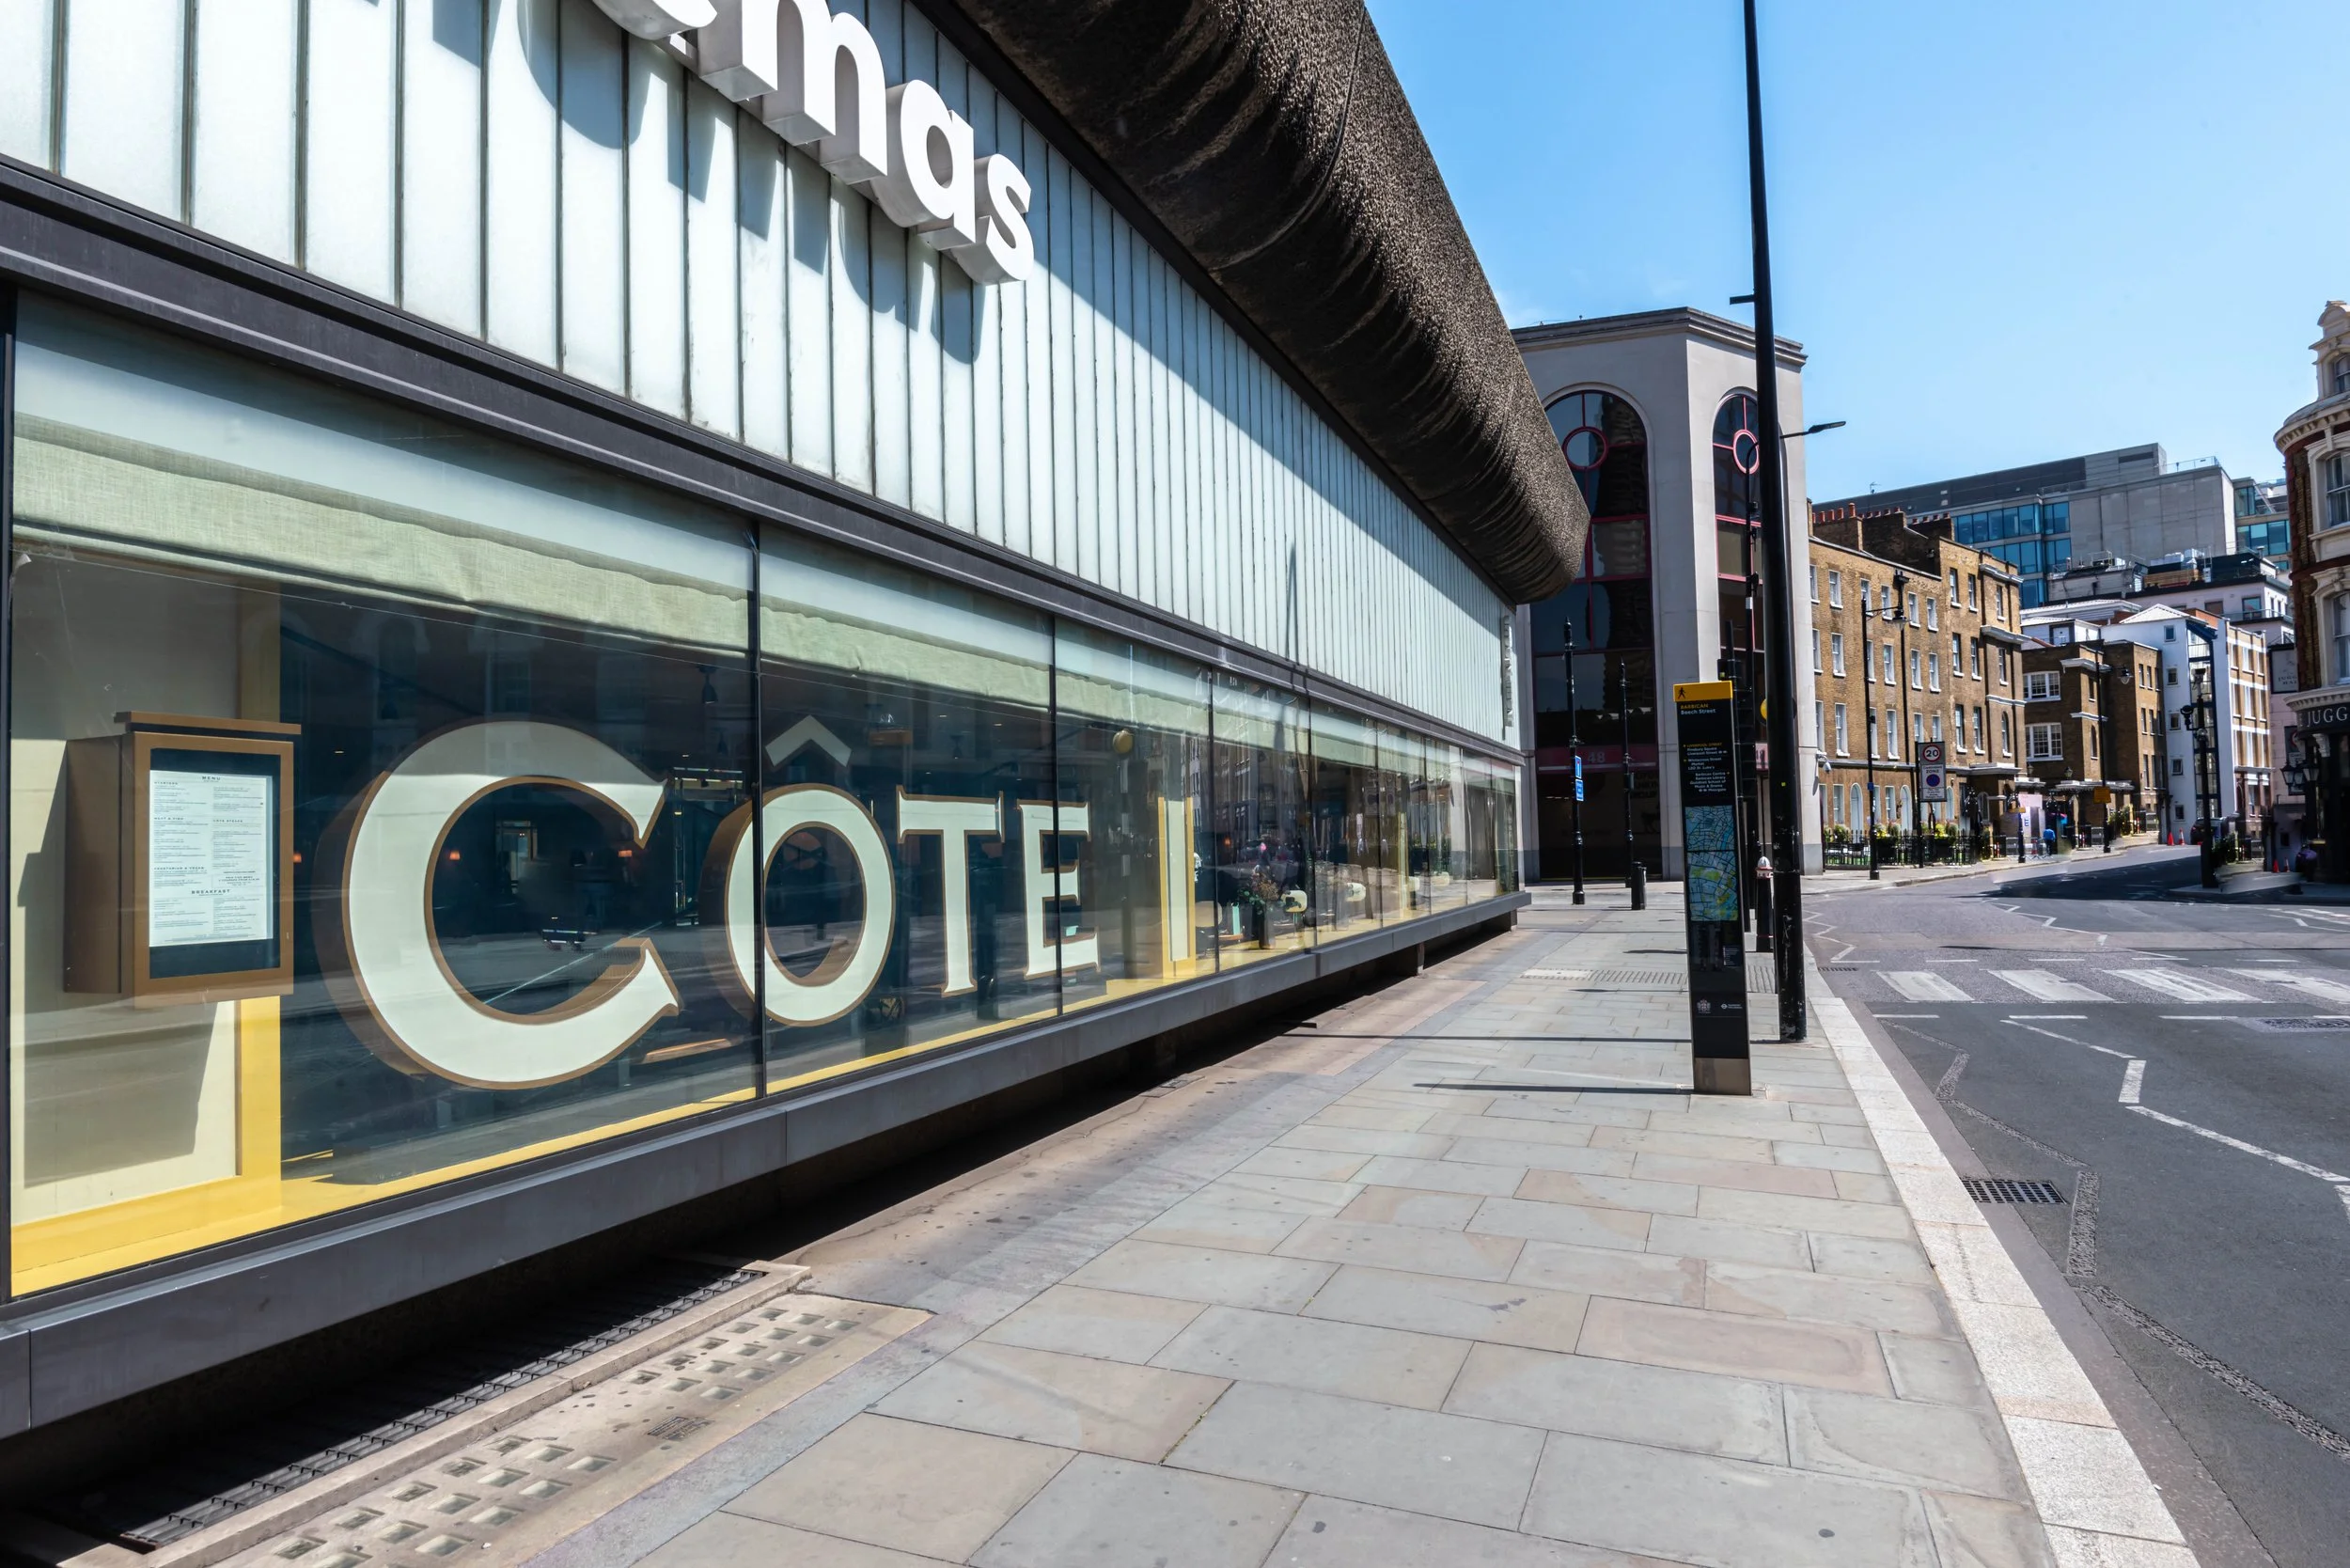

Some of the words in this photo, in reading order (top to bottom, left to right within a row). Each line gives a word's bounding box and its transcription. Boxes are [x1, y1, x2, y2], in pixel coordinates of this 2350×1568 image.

[593, 0, 1035, 285] mas
[1588, 751, 1606, 763] 48
[329, 714, 1103, 1090] CÔTE
